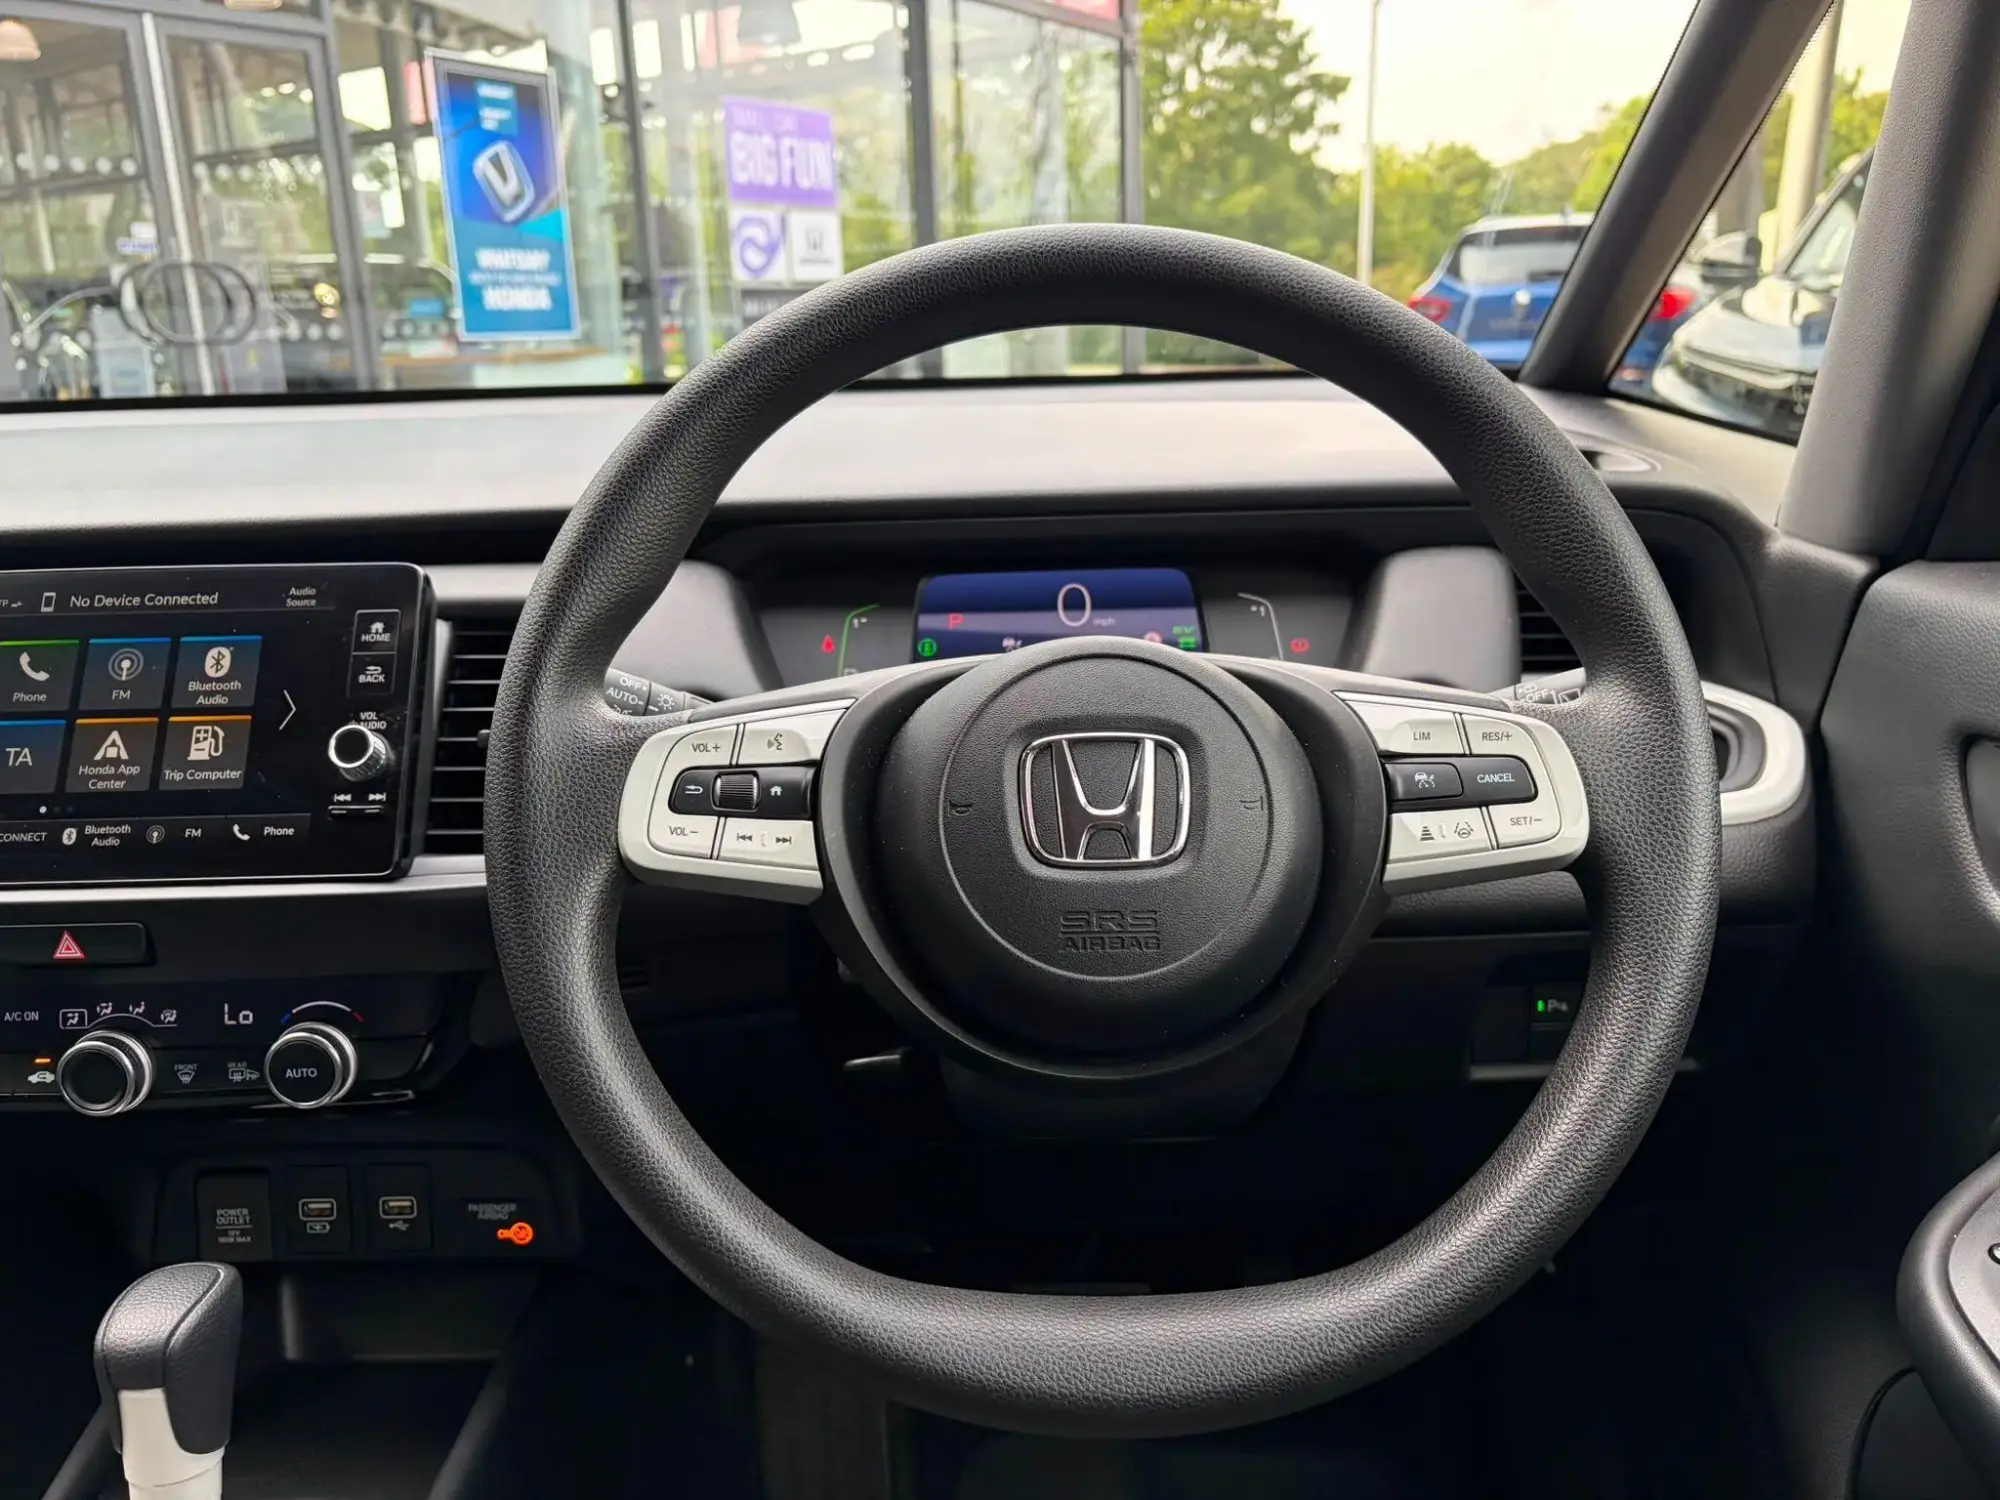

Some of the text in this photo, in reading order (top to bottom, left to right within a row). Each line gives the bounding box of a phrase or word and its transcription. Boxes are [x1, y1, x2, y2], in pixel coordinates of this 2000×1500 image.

[289, 586, 317, 596] Audio
[70, 591, 220, 607] No Device Connected
[286, 598, 317, 607] Source
[1057, 583, 1092, 628] 0
[948, 612, 964, 631] P
[361, 633, 391, 642] HOME
[358, 674, 385, 684] BACK
[620, 676, 642, 690] OFF
[188, 681, 242, 692] Bluetooth
[12, 692, 47, 702] Phone
[112, 690, 131, 700] FM
[196, 695, 229, 705] Audio
[606, 687, 639, 705] AUTO
[1526, 688, 1550, 703] OFF
[360, 711, 378, 720] VOL
[1413, 731, 1431, 741] LIM
[6, 747, 33, 767] TA
[78, 764, 141, 776] Honda App
[164, 769, 242, 781] Trip Computer
[1477, 773, 1515, 783] CANCEL
[88, 778, 126, 789] Center
[85, 824, 131, 834] Bluetooth
[185, 828, 202, 838] FM
[264, 826, 295, 836] Phone
[91, 837, 120, 846] Audio
[1059, 910, 1159, 933] SRS
[1059, 935, 1161, 953] AIRBAG
[4, 1011, 39, 1021] A/C ON
[285, 1068, 318, 1078] AUTO
[216, 1208, 249, 1216] POWER
[216, 1216, 250, 1225] OUTLET
